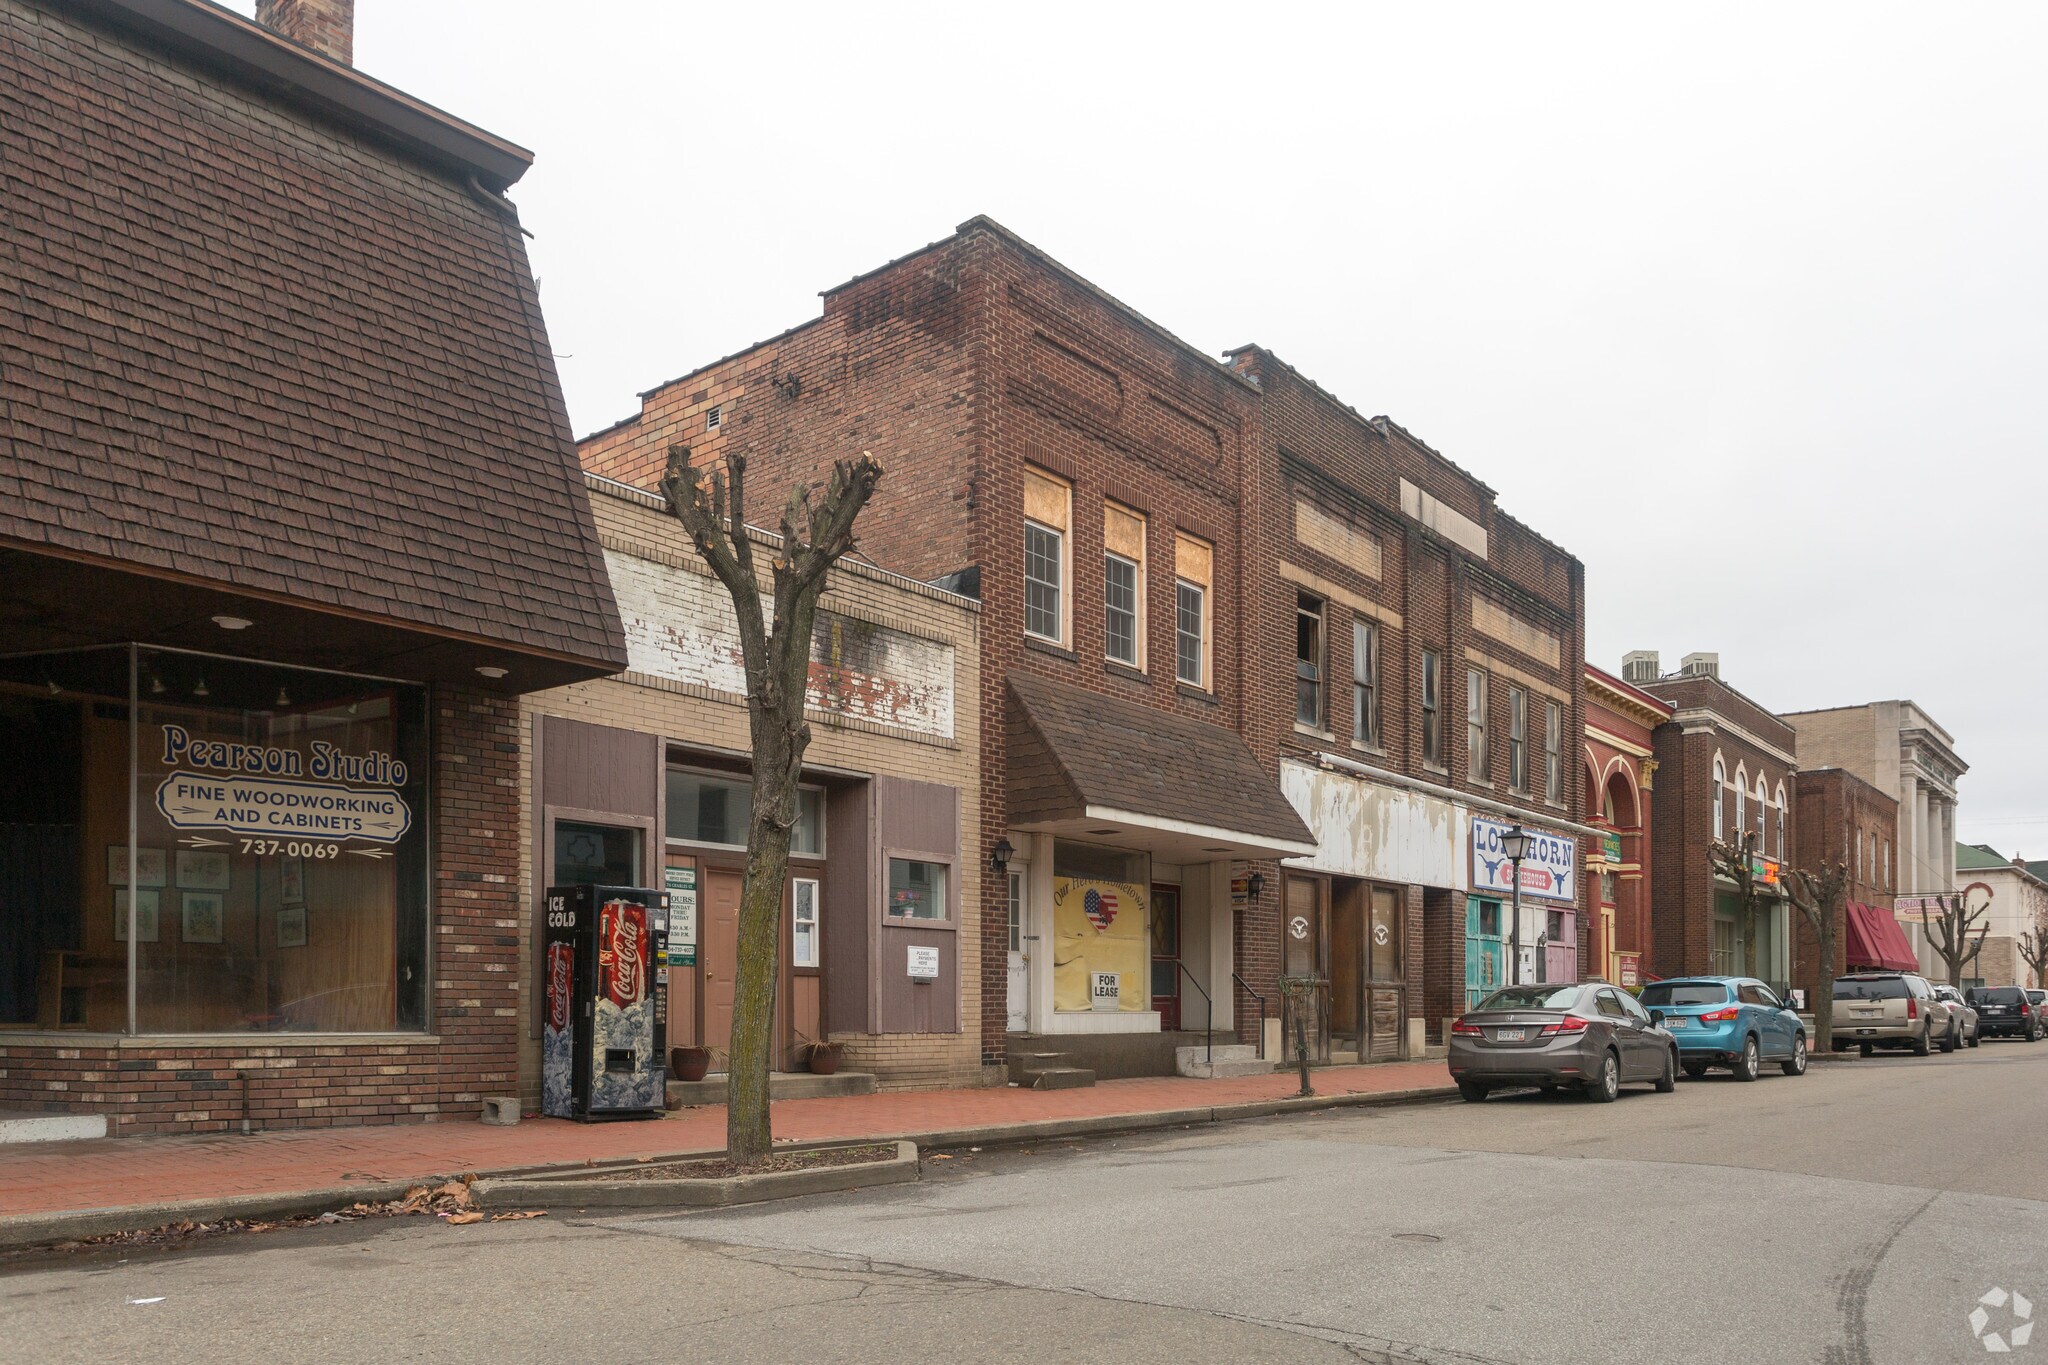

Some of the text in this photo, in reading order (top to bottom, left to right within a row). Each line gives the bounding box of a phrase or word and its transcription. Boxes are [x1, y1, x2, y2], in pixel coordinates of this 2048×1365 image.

[162, 724, 408, 786] Pearson Studio
[177, 784, 394, 815] FINE WOODWORKING
[214, 807, 363, 831] AND CABINETS
[239, 838, 339, 860] 737-0069
[671, 895, 695, 903] OURS:
[1053, 881, 1070, 907] Our
[549, 896, 565, 912] ICE
[548, 911, 576, 928] COLD
[1098, 975, 1116, 985] FOR
[1094, 986, 1119, 997] LEASE
